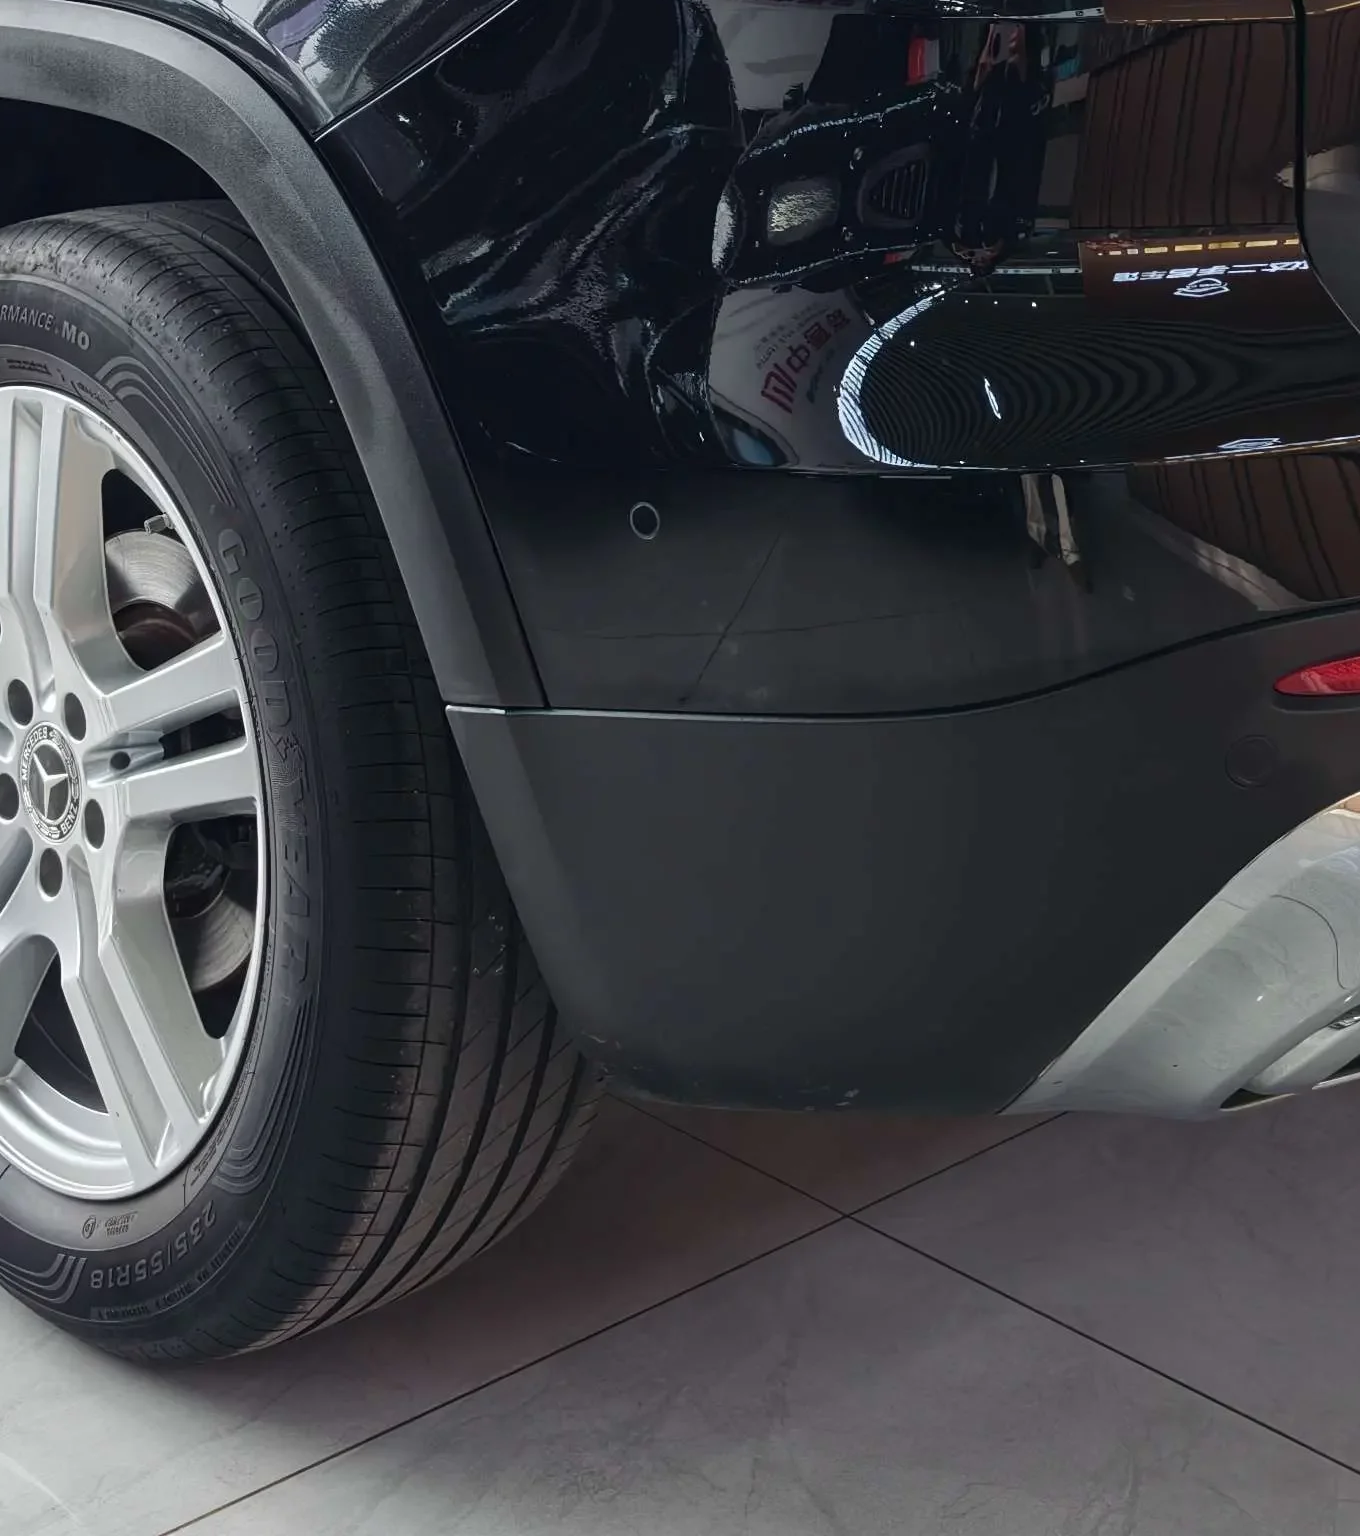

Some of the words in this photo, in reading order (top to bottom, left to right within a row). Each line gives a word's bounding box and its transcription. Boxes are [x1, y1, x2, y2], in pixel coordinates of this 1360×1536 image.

[61, 320, 90, 352] MO
[21, 726, 48, 781] MERCEDES
[59, 802, 78, 835] BENZ
[90, 1199, 217, 1290] 235/55R18
